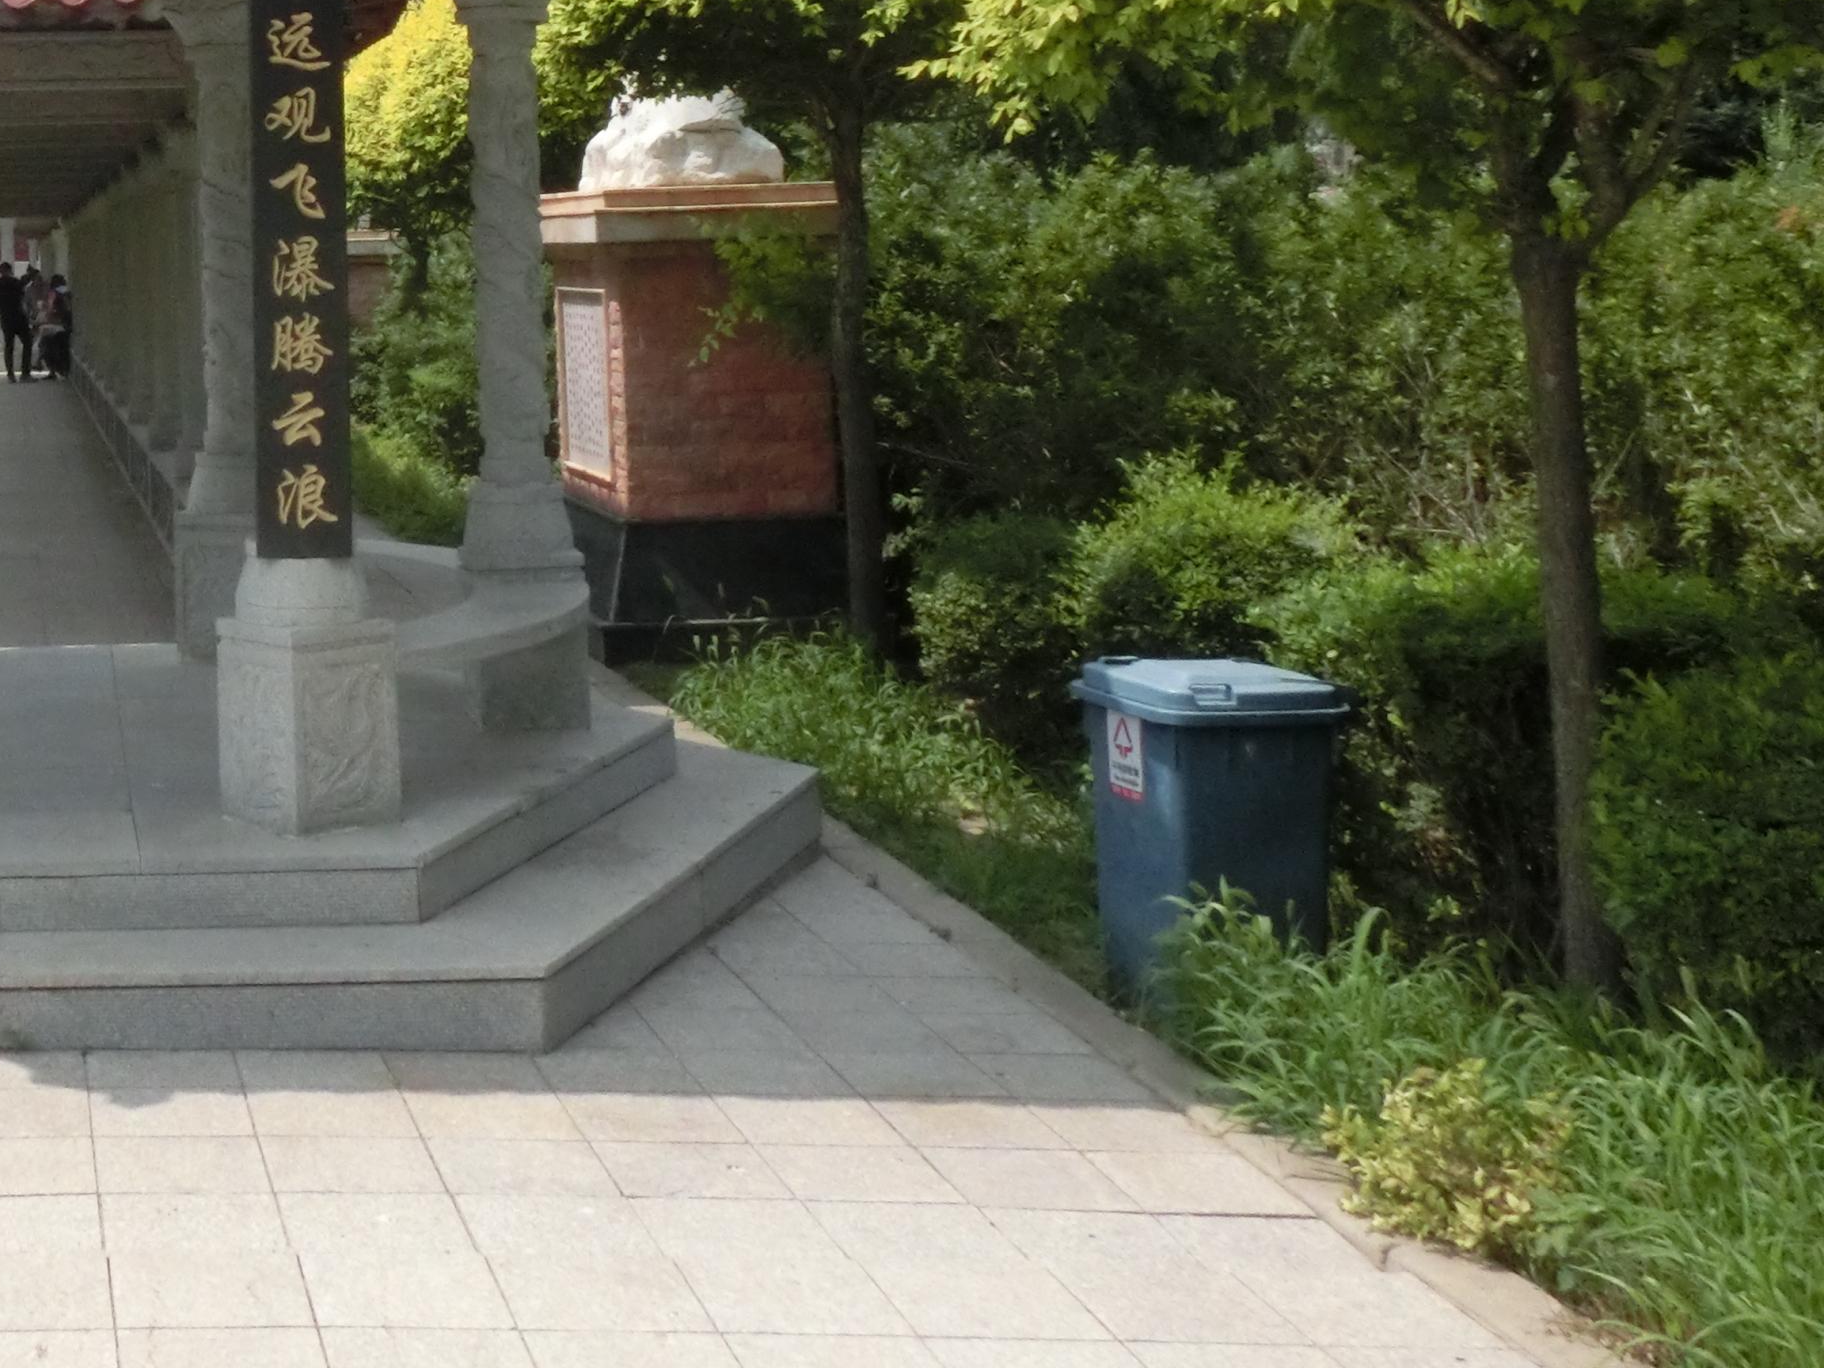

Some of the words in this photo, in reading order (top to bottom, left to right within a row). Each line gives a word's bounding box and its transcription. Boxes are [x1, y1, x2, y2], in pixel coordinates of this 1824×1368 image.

[264, 11, 339, 529] 远观飞瀑腾云浪
